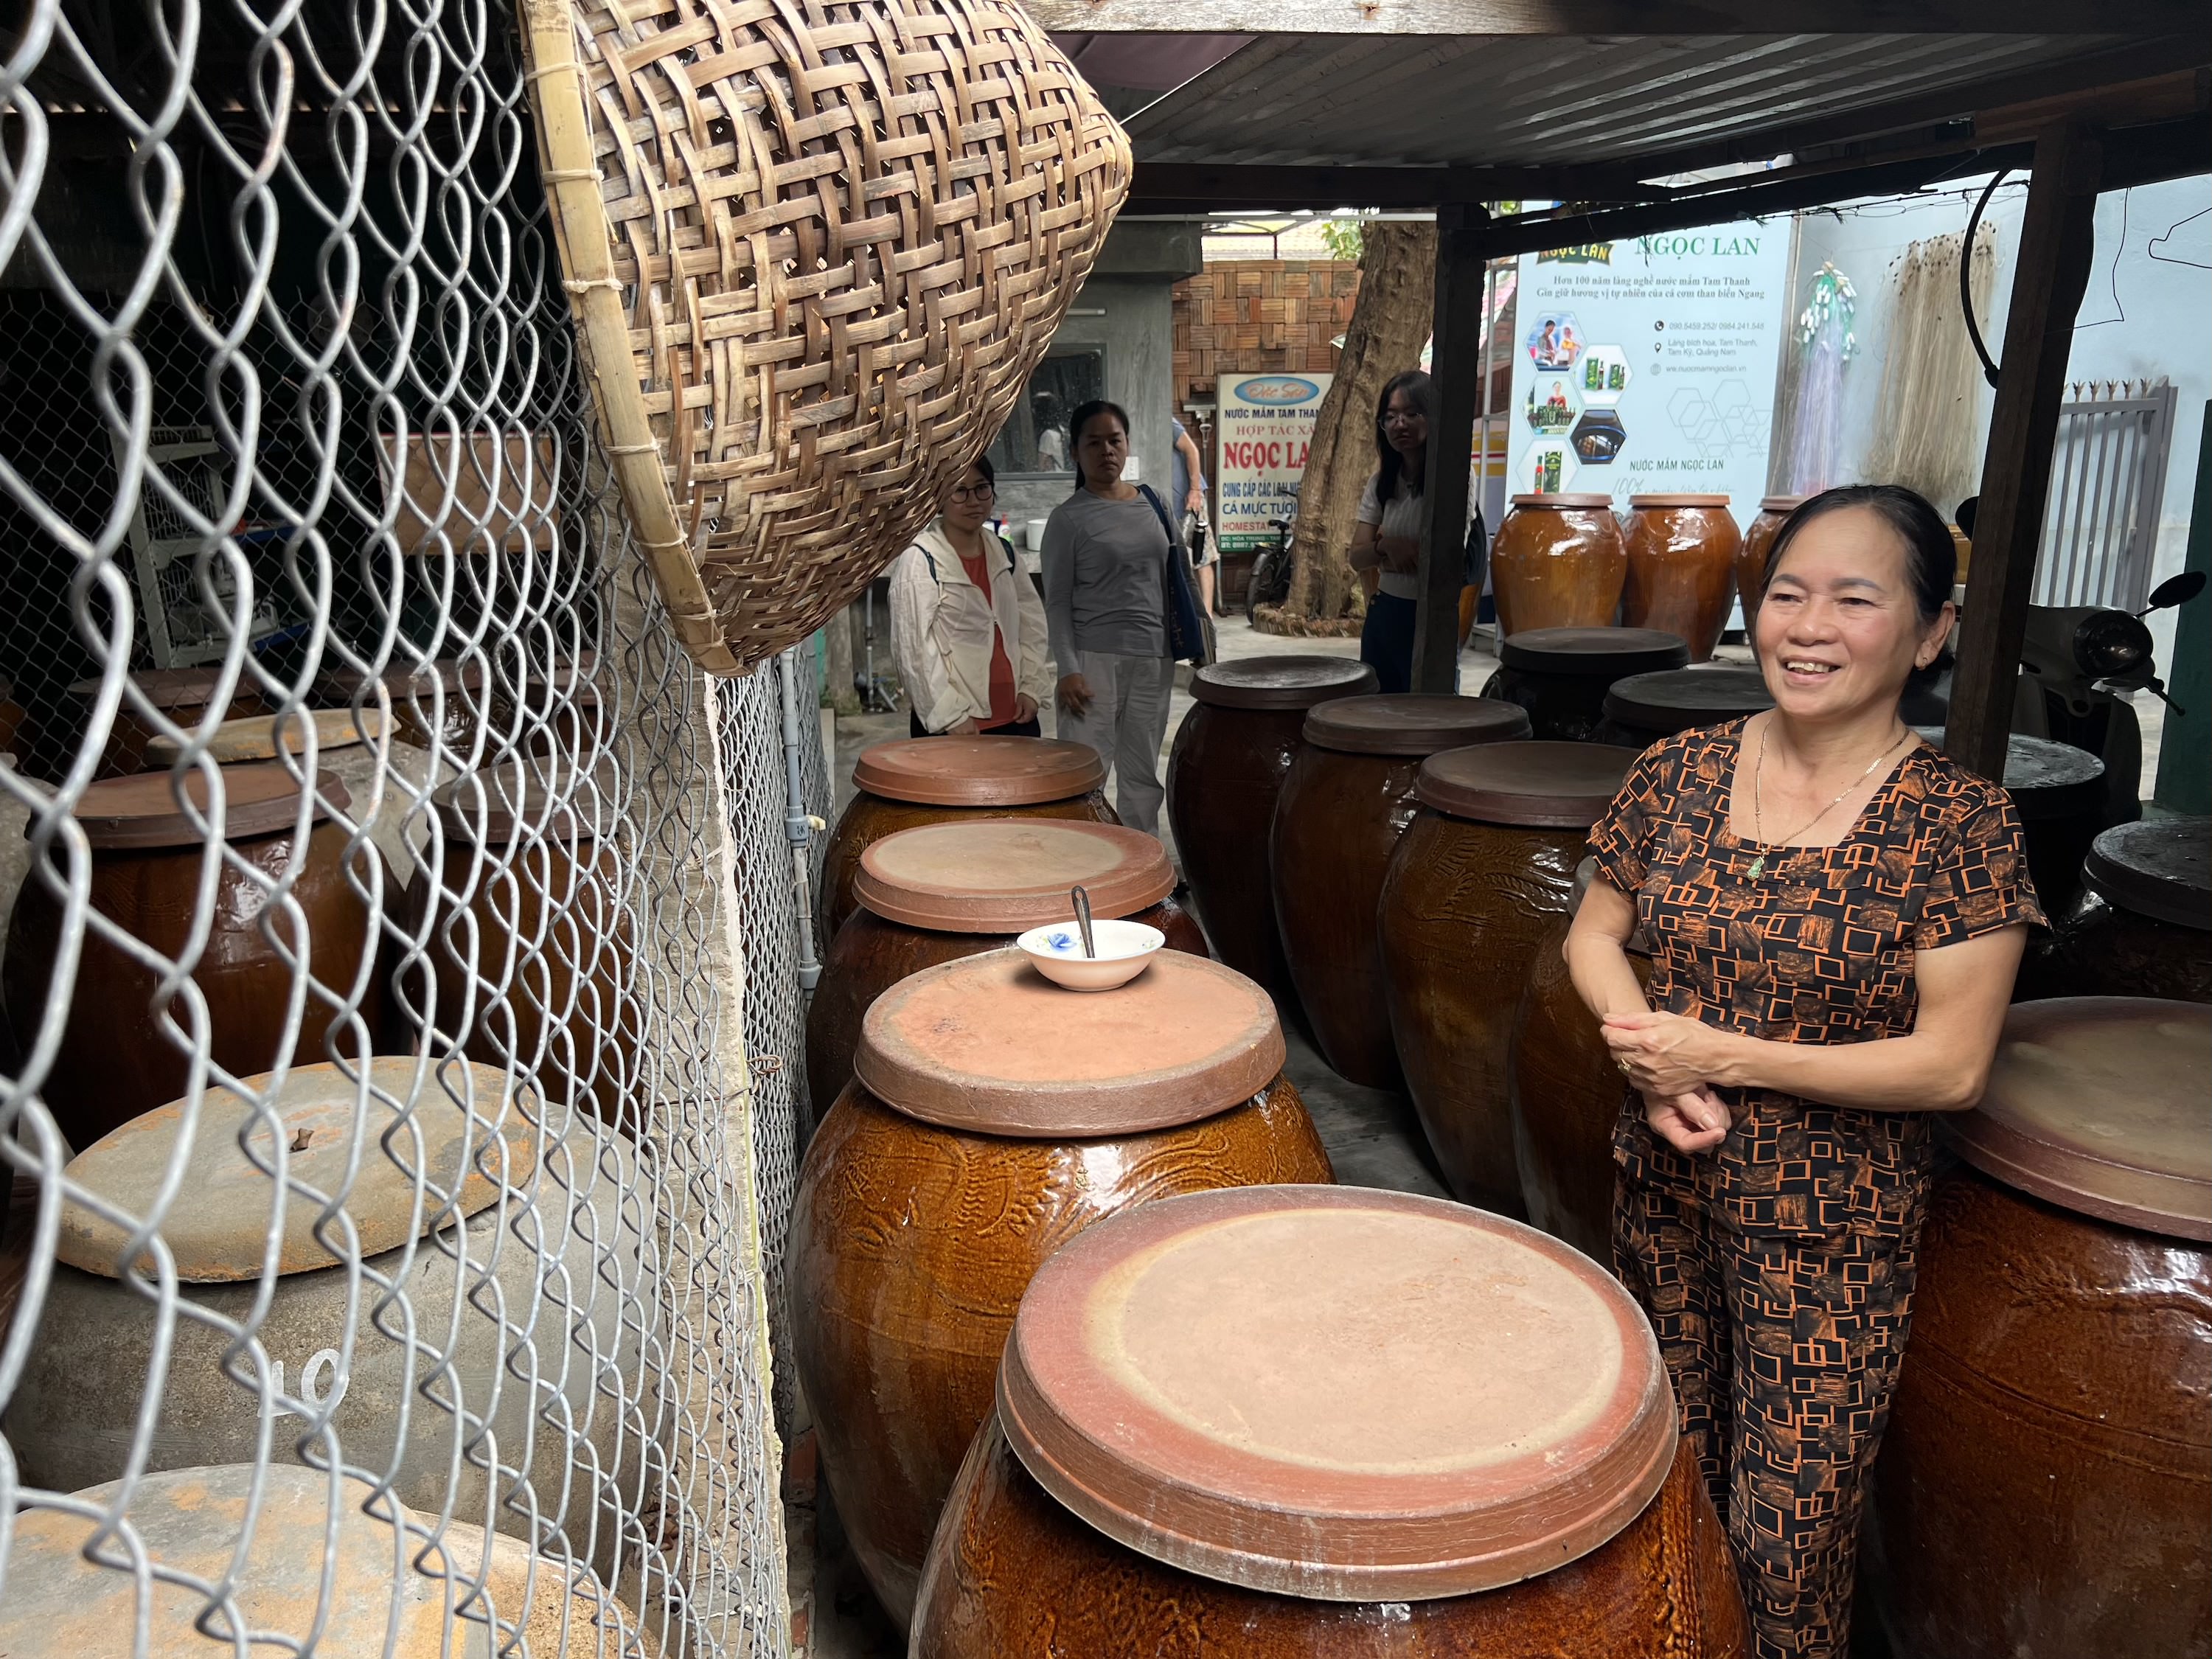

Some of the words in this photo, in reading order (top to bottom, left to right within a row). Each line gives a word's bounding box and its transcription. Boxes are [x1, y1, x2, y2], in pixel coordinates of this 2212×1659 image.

[1581, 243, 1608, 260] LAN
[1635, 235, 1705, 260] NGỌC
[1711, 237, 1761, 256] LAN
[1554, 275, 1573, 285] Hơn
[1575, 275, 1590, 285] 100
[1592, 276, 1611, 285] năm
[1613, 276, 1632, 287] làng
[1633, 273, 1654, 287] nghề
[1655, 276, 1677, 285] nước
[1703, 276, 1721, 285] Tam
[1722, 276, 1750, 285] Thanh
[1571, 288, 1599, 299] hương
[1622, 288, 1646, 297] nhiên
[1648, 288, 1663, 298] của
[1665, 288, 1674, 298] cá
[1697, 288, 1715, 298] than
[1737, 288, 1764, 300] Ngang
[1225, 407, 1249, 419] NƯỚC
[1277, 409, 1295, 419] TAM
[1298, 409, 1319, 419] THAN
[1237, 425, 1265, 438] HỢP
[1268, 422, 1294, 435] TÁC
[1223, 442, 1281, 476] NGỌC
[1286, 442, 1310, 469] LA
[1630, 459, 1653, 471] NƯỚC
[1680, 459, 1704, 472] NGỌC
[1707, 459, 1724, 470] LAN
[1222, 482, 1241, 497] CUNG
[1242, 476, 1256, 497] CẤP
[1258, 479, 1271, 497] CÁC
[1241, 501, 1267, 518] MỰC
